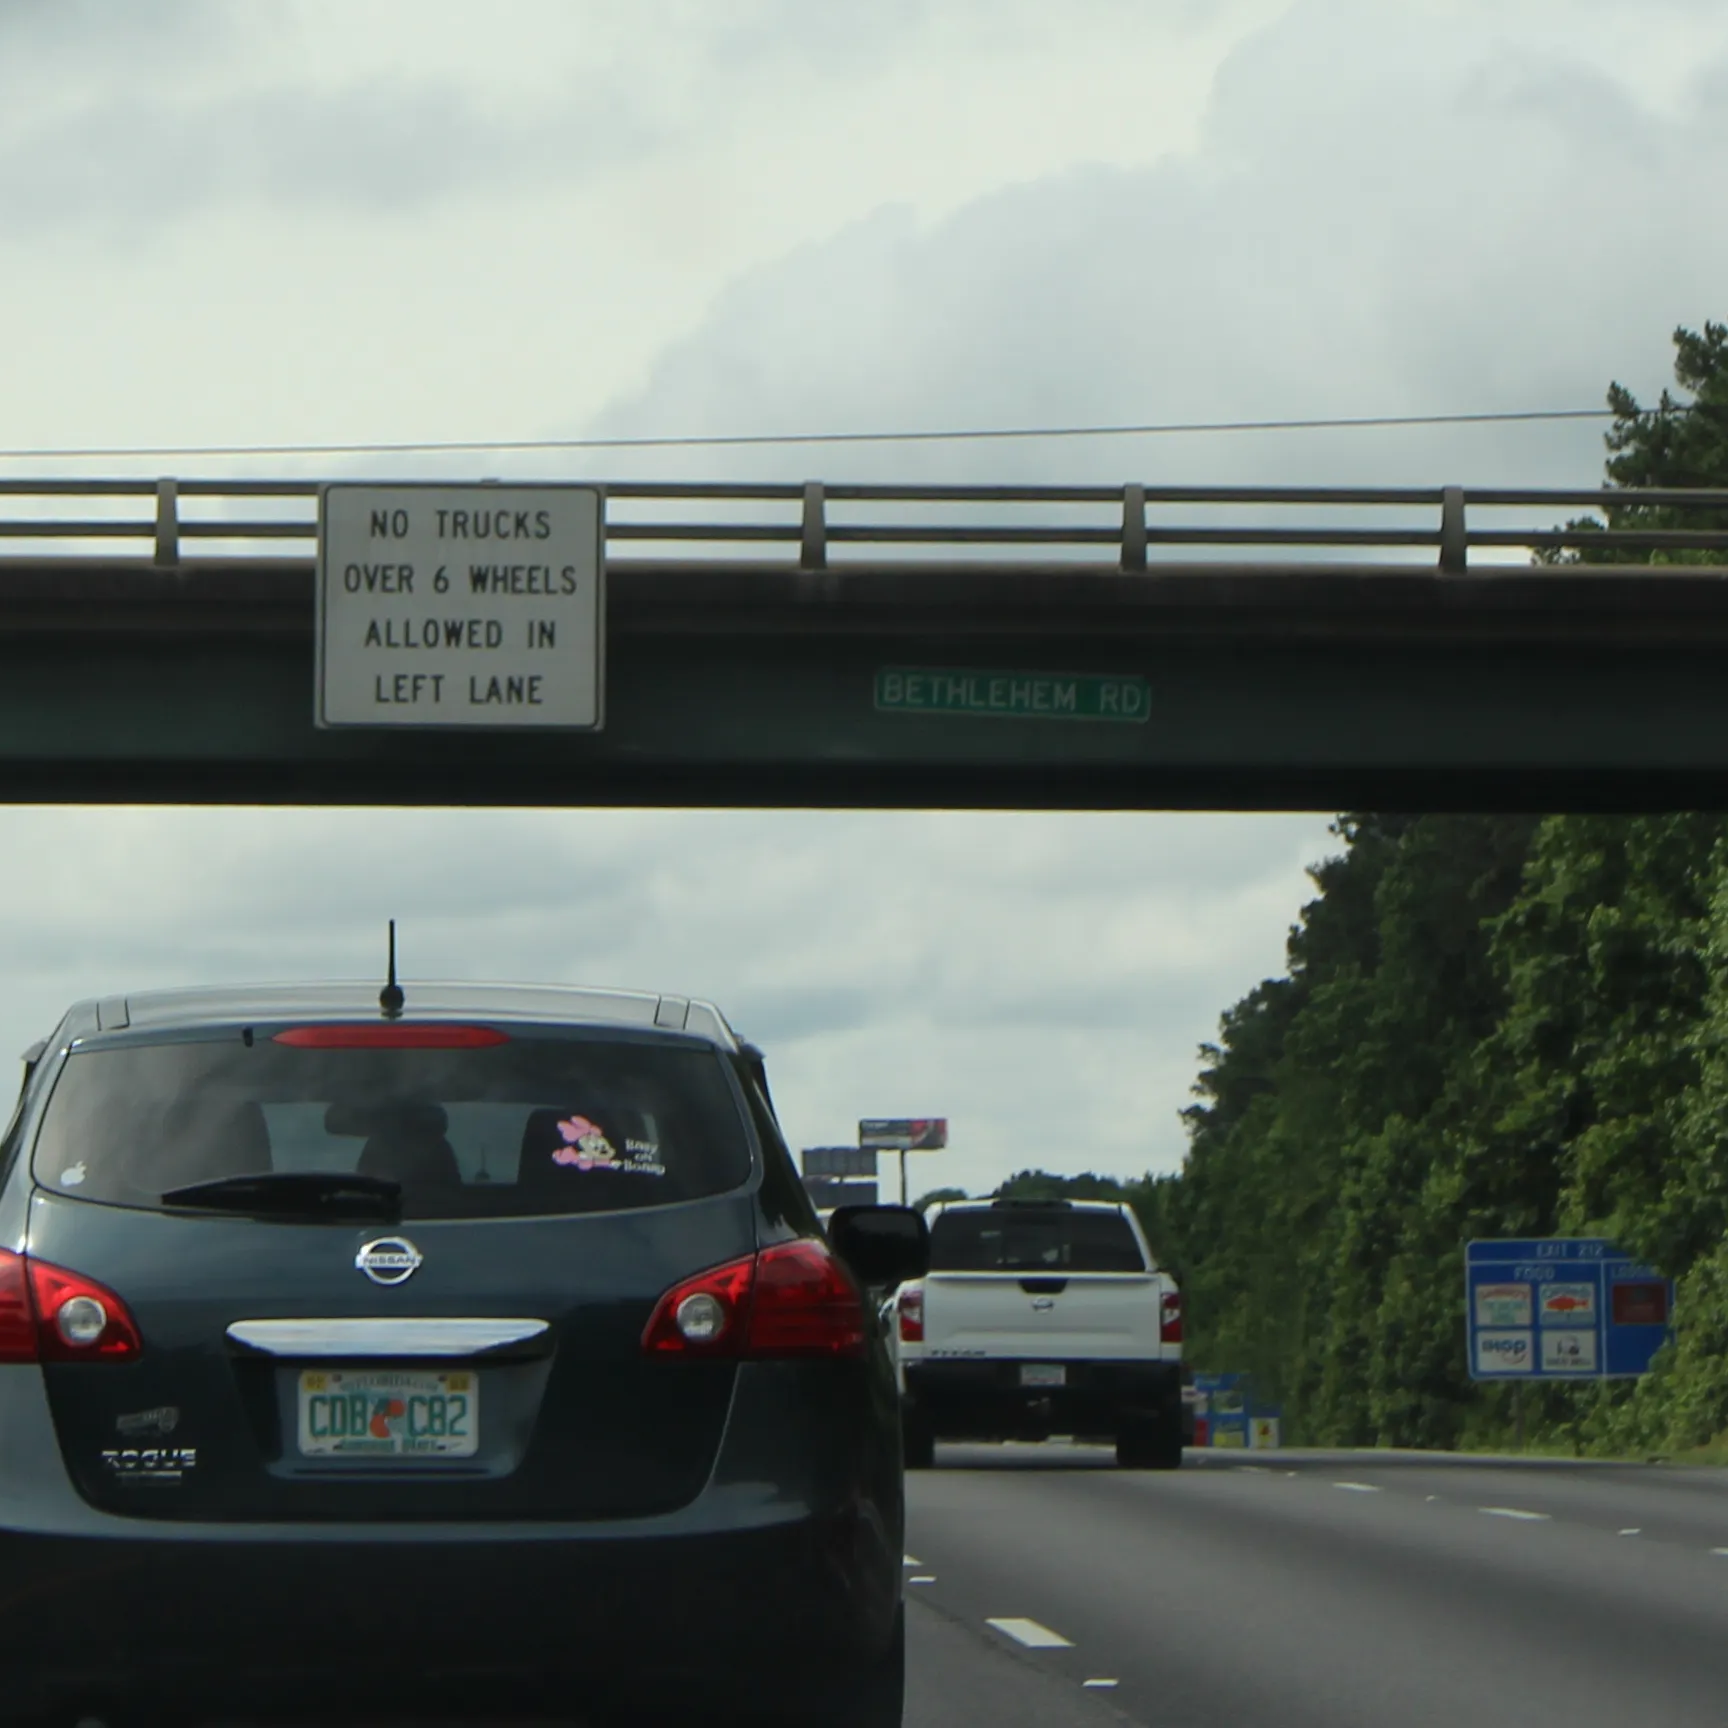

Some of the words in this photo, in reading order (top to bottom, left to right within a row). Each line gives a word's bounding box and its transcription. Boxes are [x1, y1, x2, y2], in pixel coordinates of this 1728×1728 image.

[370, 509, 409, 539] NO
[436, 510, 551, 540] TRUCKS
[344, 564, 414, 593] OVER
[433, 565, 450, 594] 6
[469, 565, 577, 595] WHEELS
[364, 619, 503, 649] ALLOWED
[527, 620, 556, 649] IN
[375, 674, 445, 704] LEFT
[469, 675, 543, 704] LANE
[883, 674, 1076, 710] BETHLEHEM
[1099, 683, 1142, 713] RD
[363, 1255, 416, 1265] NISSAN
[1536, 1244, 1568, 1259] EXIT
[1578, 1243, 1604, 1258] 212
[1513, 1266, 1555, 1281] FOOD
[101, 1448, 197, 1469] ROGUE
